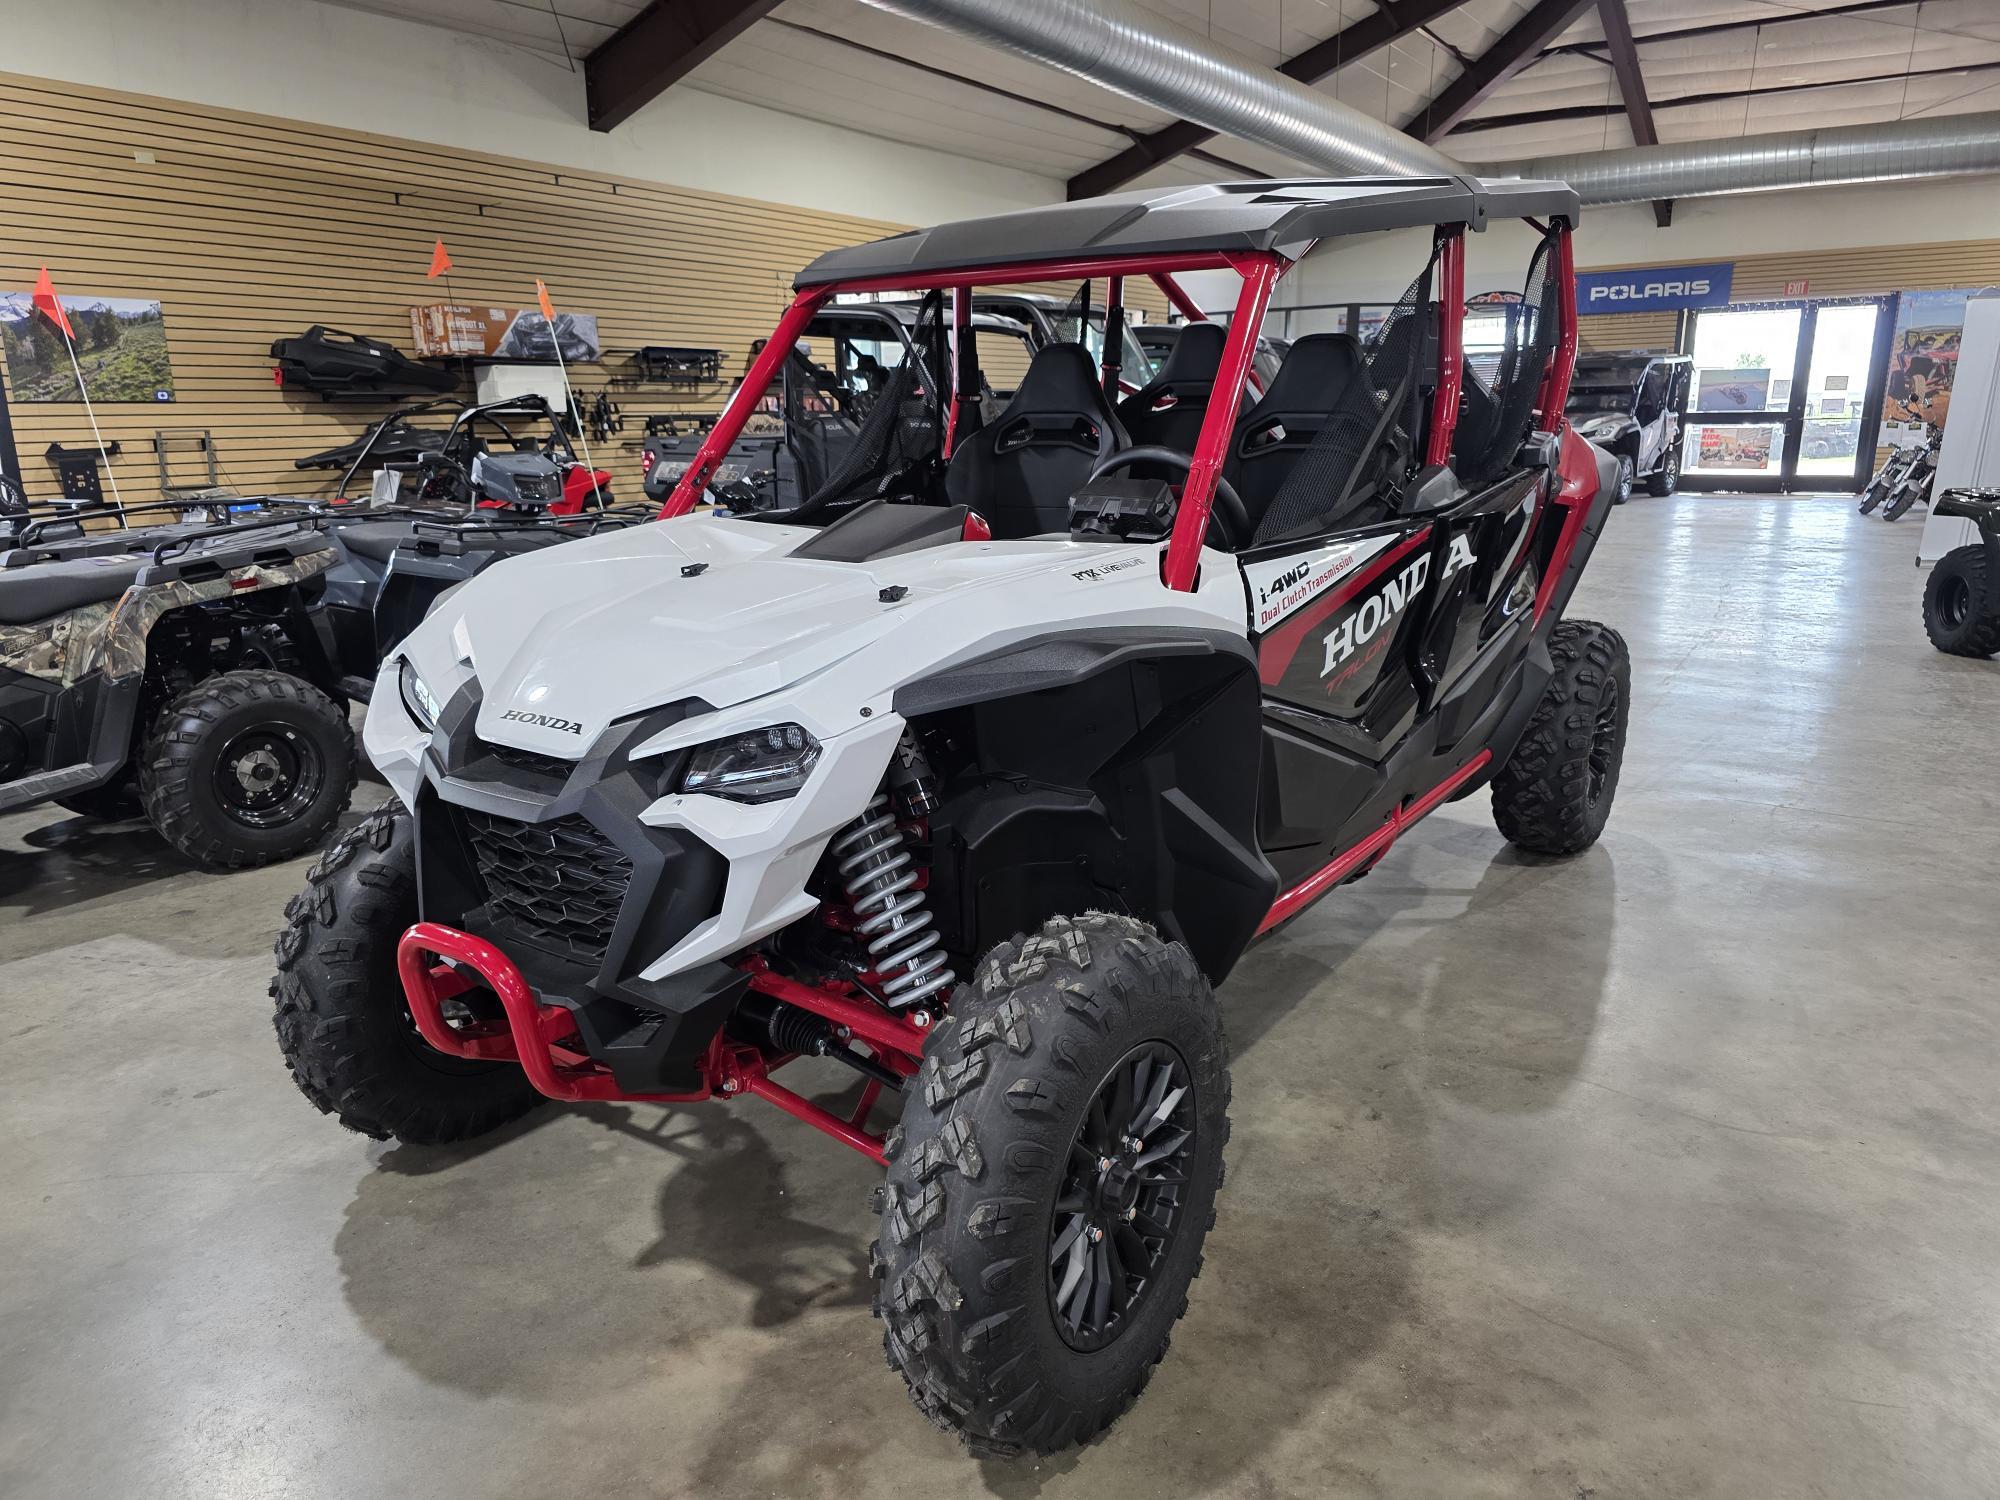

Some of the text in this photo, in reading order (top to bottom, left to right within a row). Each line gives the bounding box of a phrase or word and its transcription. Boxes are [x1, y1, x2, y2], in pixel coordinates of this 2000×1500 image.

[1590, 280, 1710, 301] POLARIS
[1787, 281, 1806, 295] EXIT
[1260, 561, 1310, 605] i-4WD
[1261, 555, 1354, 626] Dual Clutch Transmission
[1319, 533, 1478, 679] HONDA
[500, 709, 583, 735] HONDA
